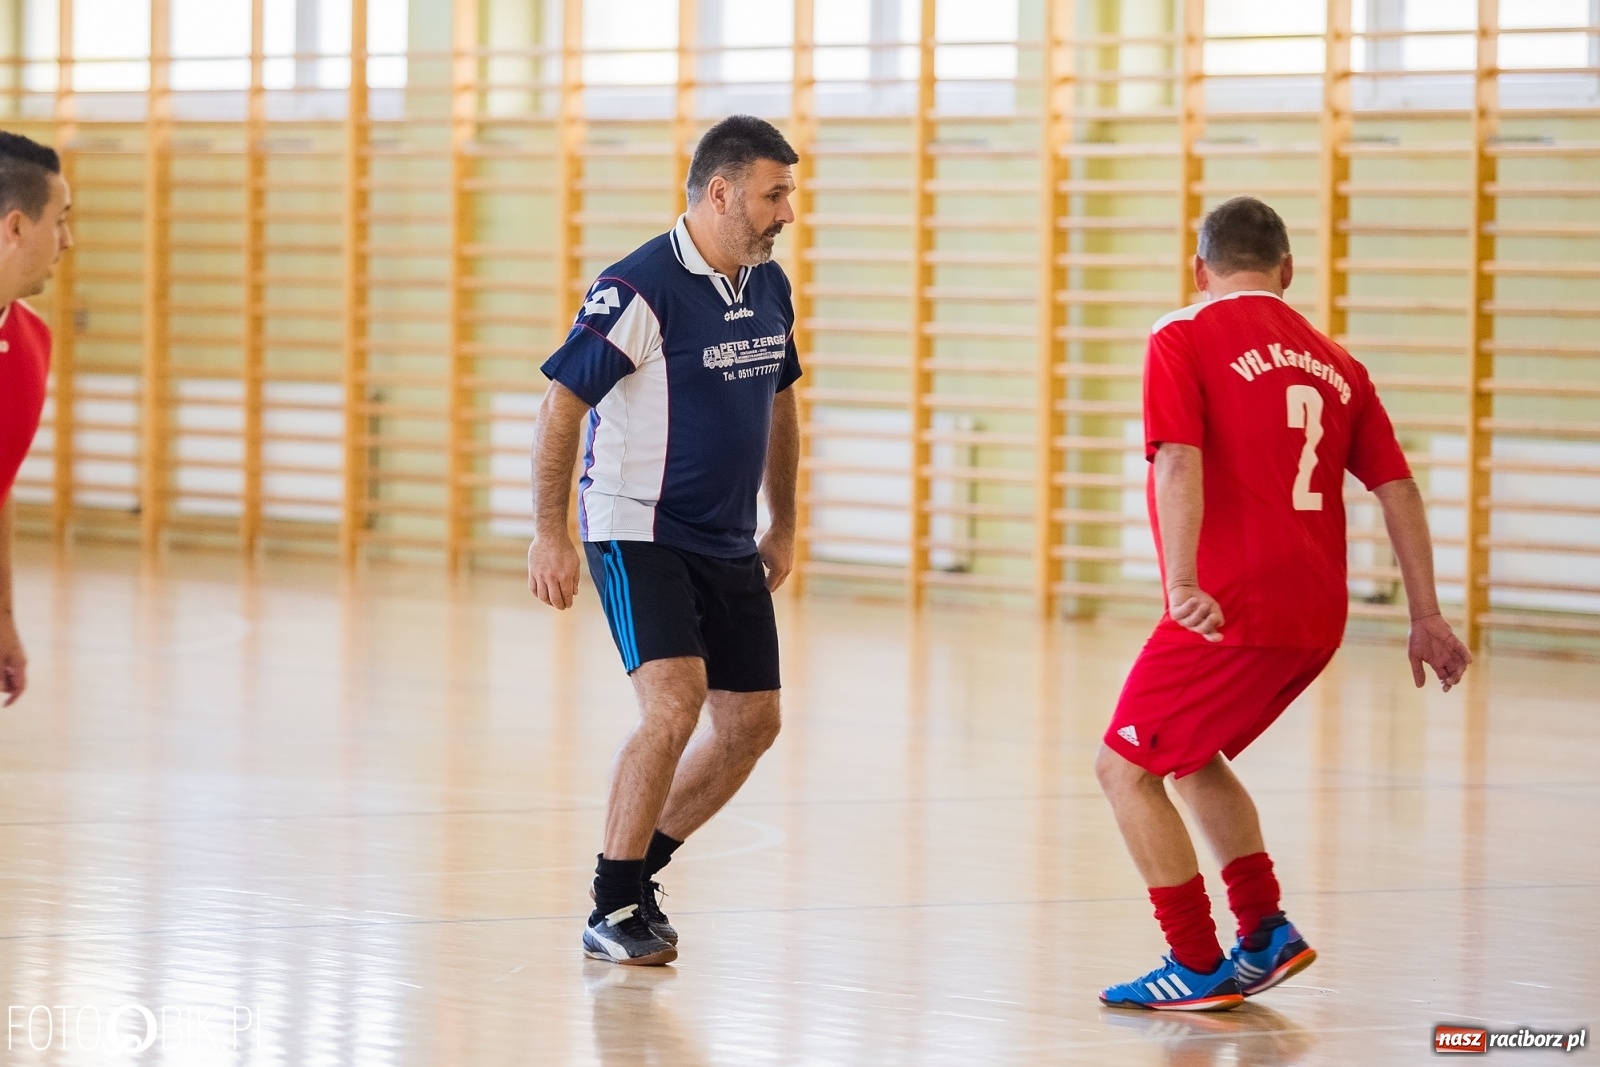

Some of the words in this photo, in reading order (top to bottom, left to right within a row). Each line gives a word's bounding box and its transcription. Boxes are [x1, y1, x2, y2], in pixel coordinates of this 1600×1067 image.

[730, 308, 754, 321] lotto
[719, 340, 750, 353] PETER
[1229, 348, 1274, 382] VfL
[723, 371, 737, 381] Tel.
[1286, 384, 1324, 511] 2
